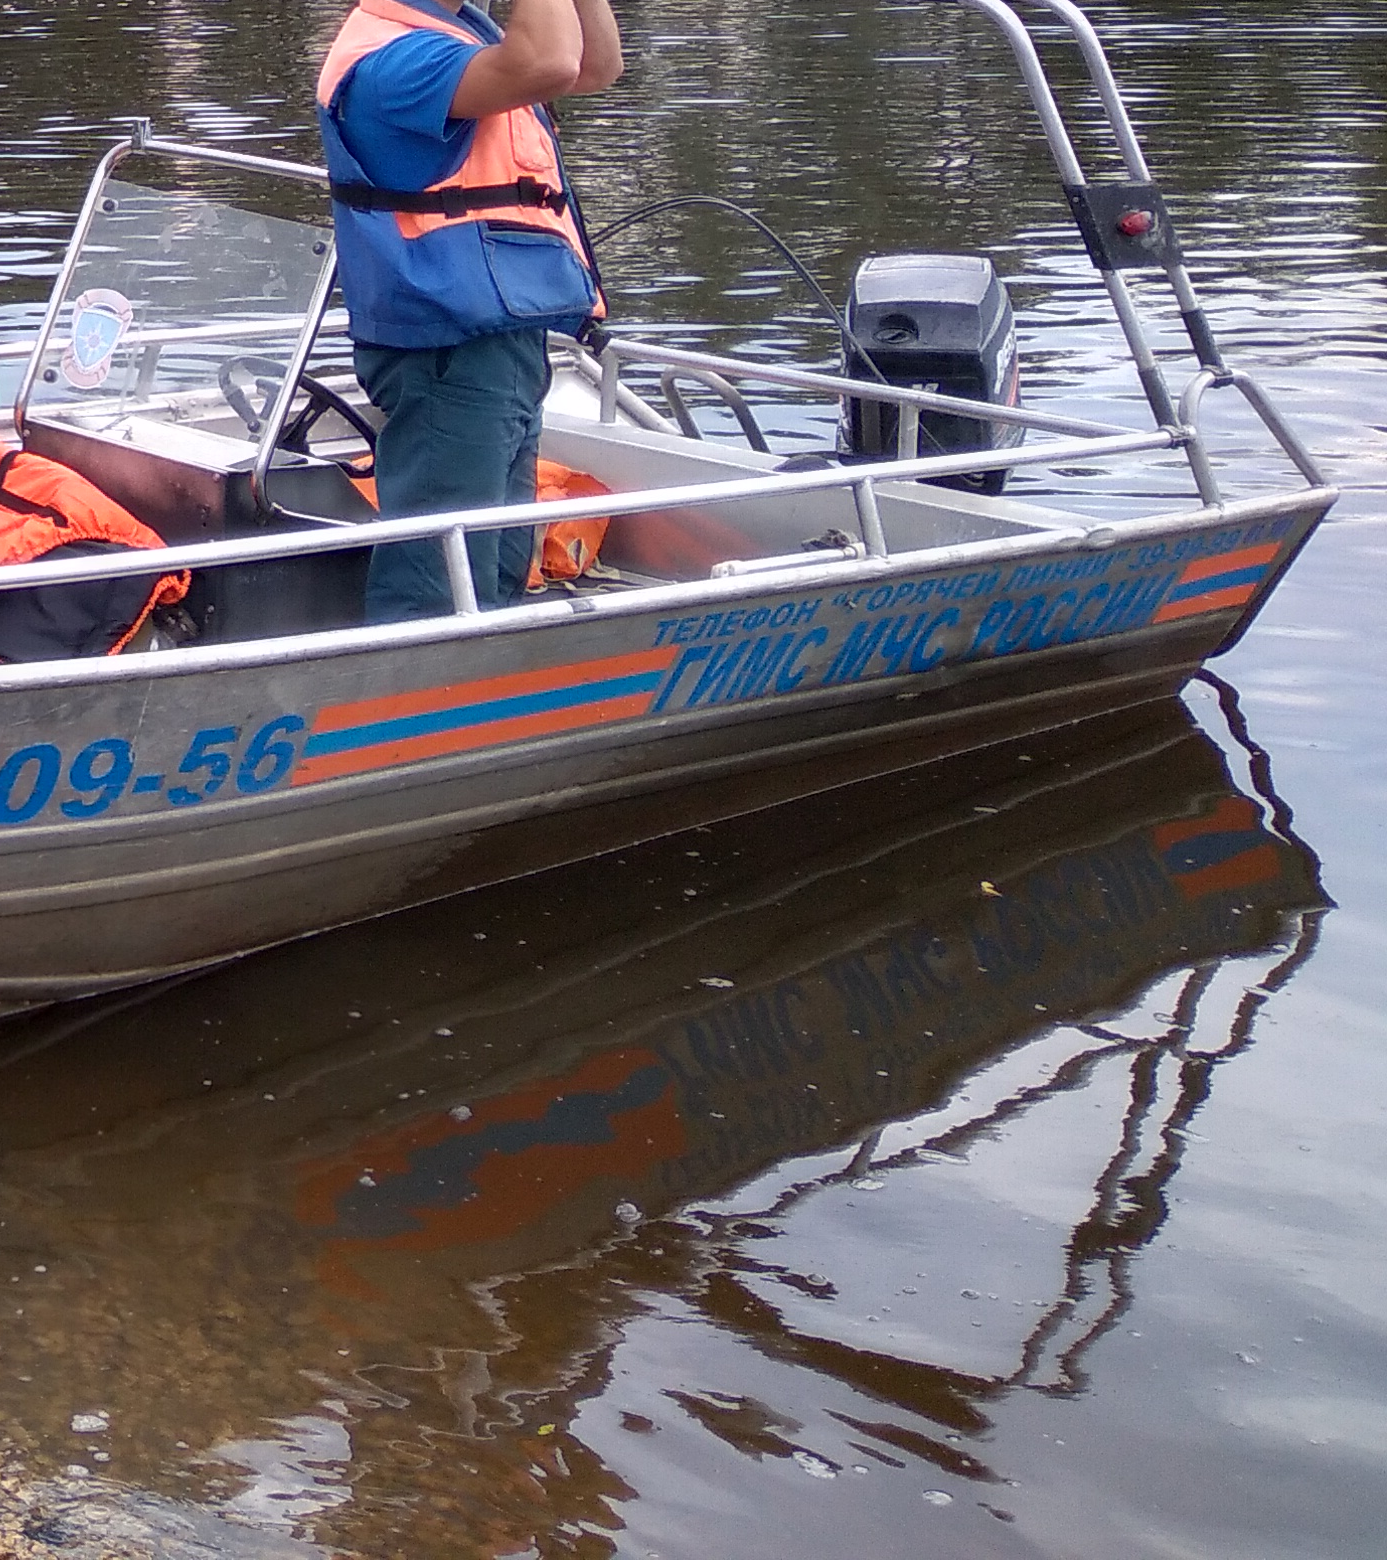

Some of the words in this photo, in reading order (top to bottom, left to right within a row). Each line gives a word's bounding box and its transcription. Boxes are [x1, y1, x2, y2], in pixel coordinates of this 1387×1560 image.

[652, 626, 828, 712] ГИМС
[822, 607, 961, 683] МЧС
[962, 571, 1176, 661] РОССИИ
[653, 598, 822, 646] ТЕЛЕФОН
